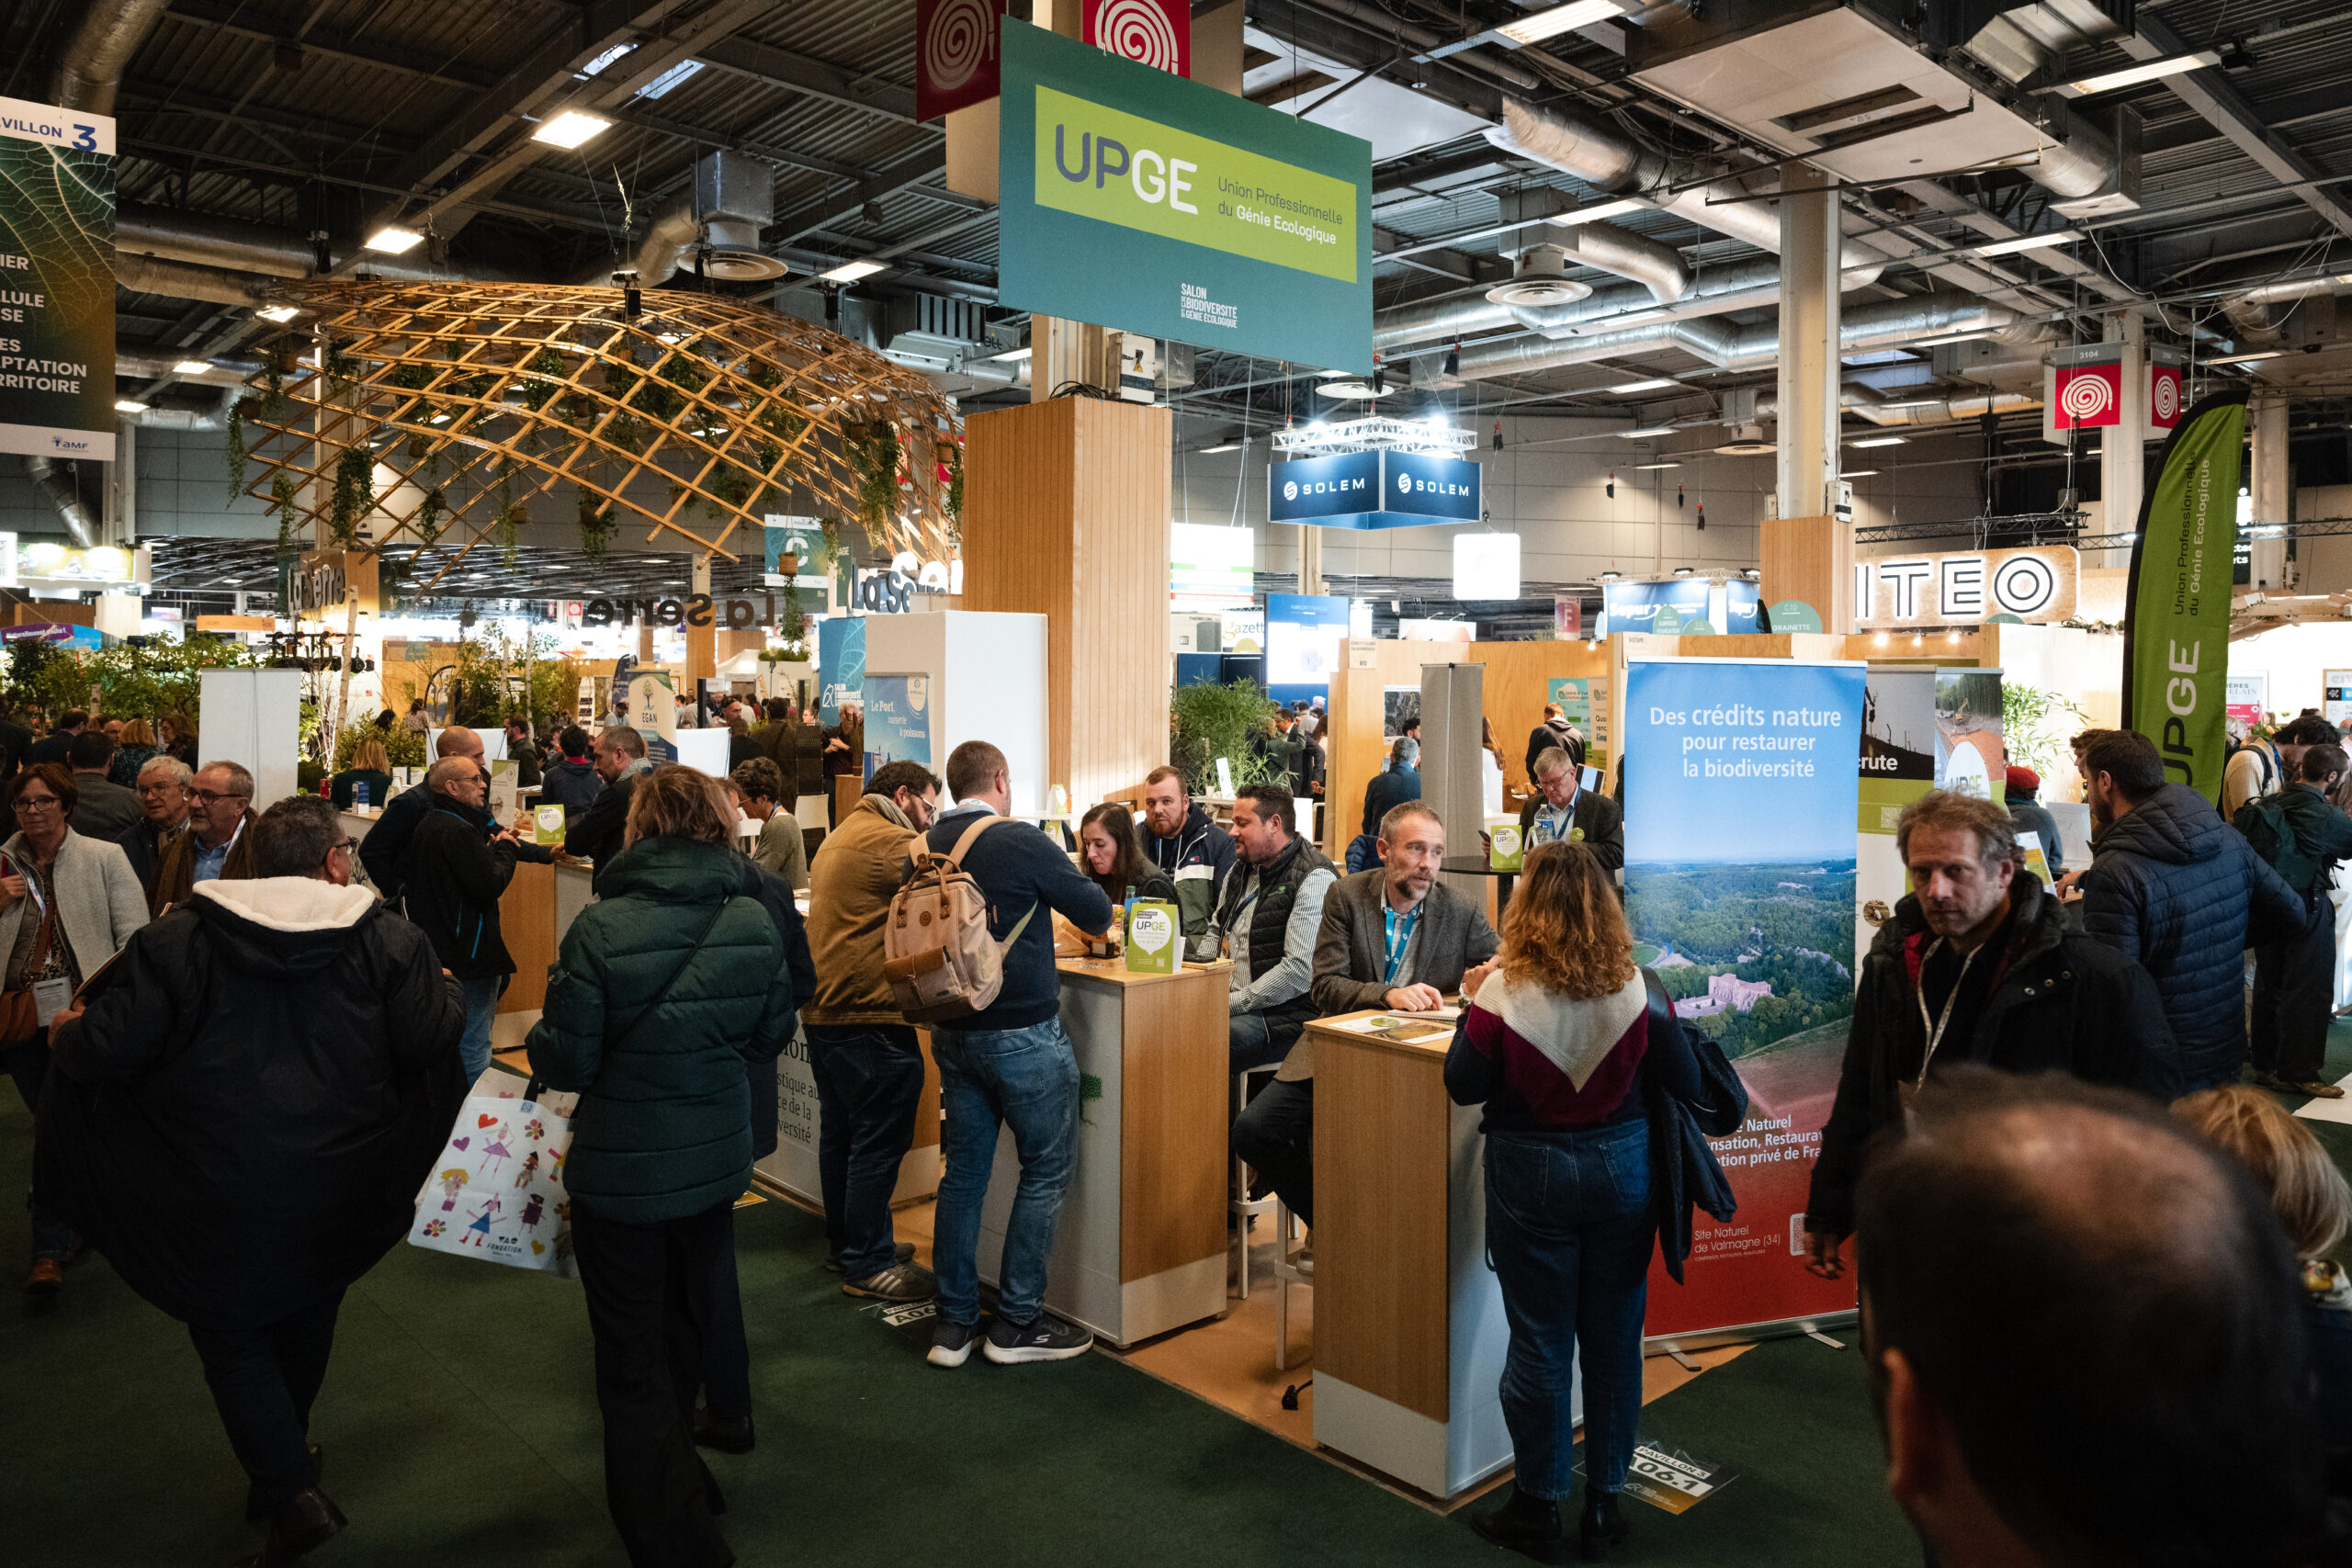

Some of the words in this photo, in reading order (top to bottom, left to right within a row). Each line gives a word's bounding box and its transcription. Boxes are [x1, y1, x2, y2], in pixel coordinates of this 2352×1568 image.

[0, 117, 62, 138] VILLON
[72, 123, 97, 152] 3
[1055, 123, 1199, 215] UPGE
[1218, 175, 1253, 199] Union
[1256, 187, 1343, 225] Professionnelle
[1218, 200, 1233, 217] du
[1237, 205, 1271, 227] Génie
[1273, 215, 1337, 244] Ecologique
[0, 289, 44, 308] LULE
[1181, 283, 1206, 299] SALON
[1186, 297, 1238, 319] BIODIVERSITÉ
[2079, 350, 2098, 359] 3104
[0, 355, 86, 378] PTATION
[1303, 478, 1365, 495] SOLEM
[1416, 479, 1469, 497] SOLEM
[2194, 459, 2210, 545] Ecologique
[2190, 549, 2202, 593] Génie
[1855, 556, 2053, 615] ITEO
[2174, 572, 2187, 616] Union
[2189, 598, 2199, 616] du
[1771, 624, 1811, 632] GRAINETTE
[870, 700, 878, 712] Le
[879, 701, 896, 714] Port,
[1650, 706, 1686, 726] Des
[1692, 704, 1764, 727] crédits
[1772, 707, 1841, 727] nature
[1683, 736, 1726, 755] pour
[1732, 735, 1815, 750] restaurer
[1683, 759, 1698, 777] la
[1704, 759, 1815, 777] biodiversité
[1136, 921, 1166, 931] UPGE
[789, 1098, 800, 1116] de
[802, 1101, 811, 1121] la
[1747, 1114, 1792, 1132] Naturel
[1749, 1148, 1781, 1168] privé
[1783, 1146, 1799, 1160] de
[1694, 1229, 1712, 1241] Site
[1714, 1225, 1749, 1238] Naturel
[487, 1242, 522, 1254] FONDATION
[1694, 1243, 1708, 1253] de
[1711, 1237, 1760, 1251] Valmagne
[1763, 1235, 1781, 1247] (34)
[1638, 1448, 1697, 1473] PAVILLON
